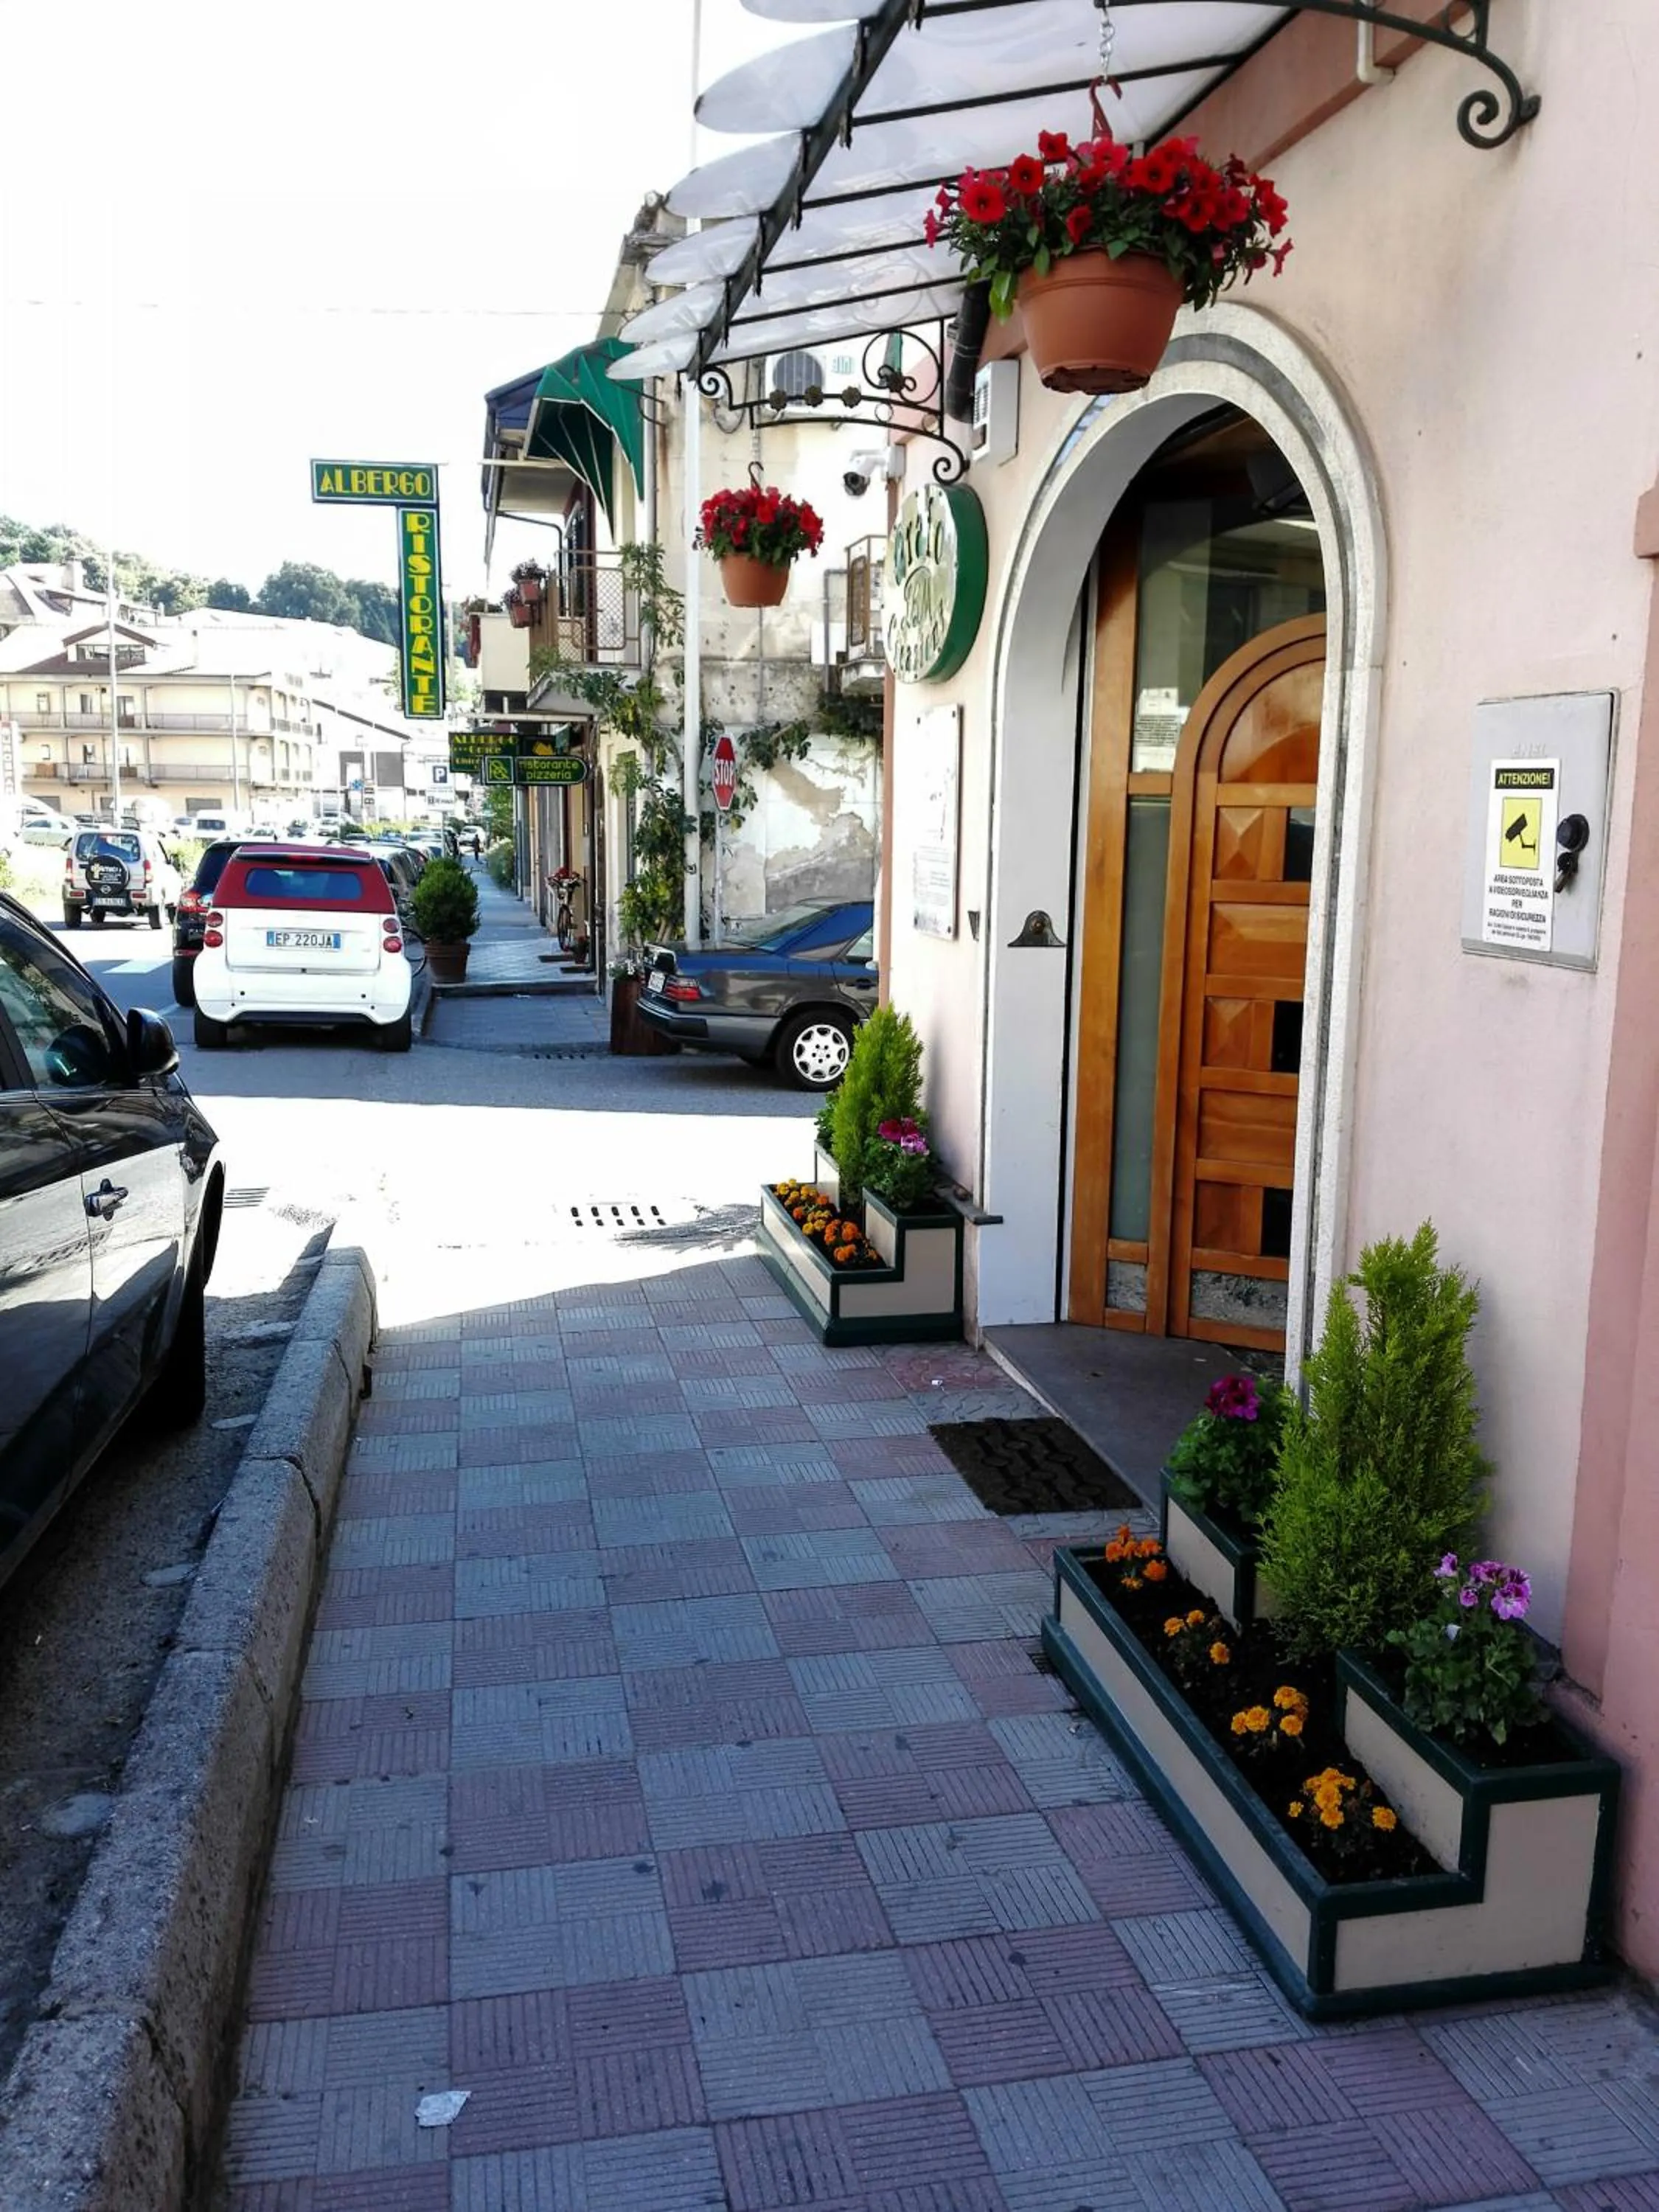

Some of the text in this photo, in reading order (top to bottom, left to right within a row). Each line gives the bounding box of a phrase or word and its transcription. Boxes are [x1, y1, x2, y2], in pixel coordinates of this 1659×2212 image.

[320, 468, 430, 495] ALBERGO
[406, 512, 437, 714] RISTORANTE
[518, 758, 580, 771] ristorante
[434, 768, 445, 782] P
[526, 771, 571, 780] pizzeria
[714, 759, 734, 785] STOP
[1494, 874, 1508, 884] AREA
[1512, 899, 1523, 908] PER
[276, 933, 332, 946] EP 220JA
